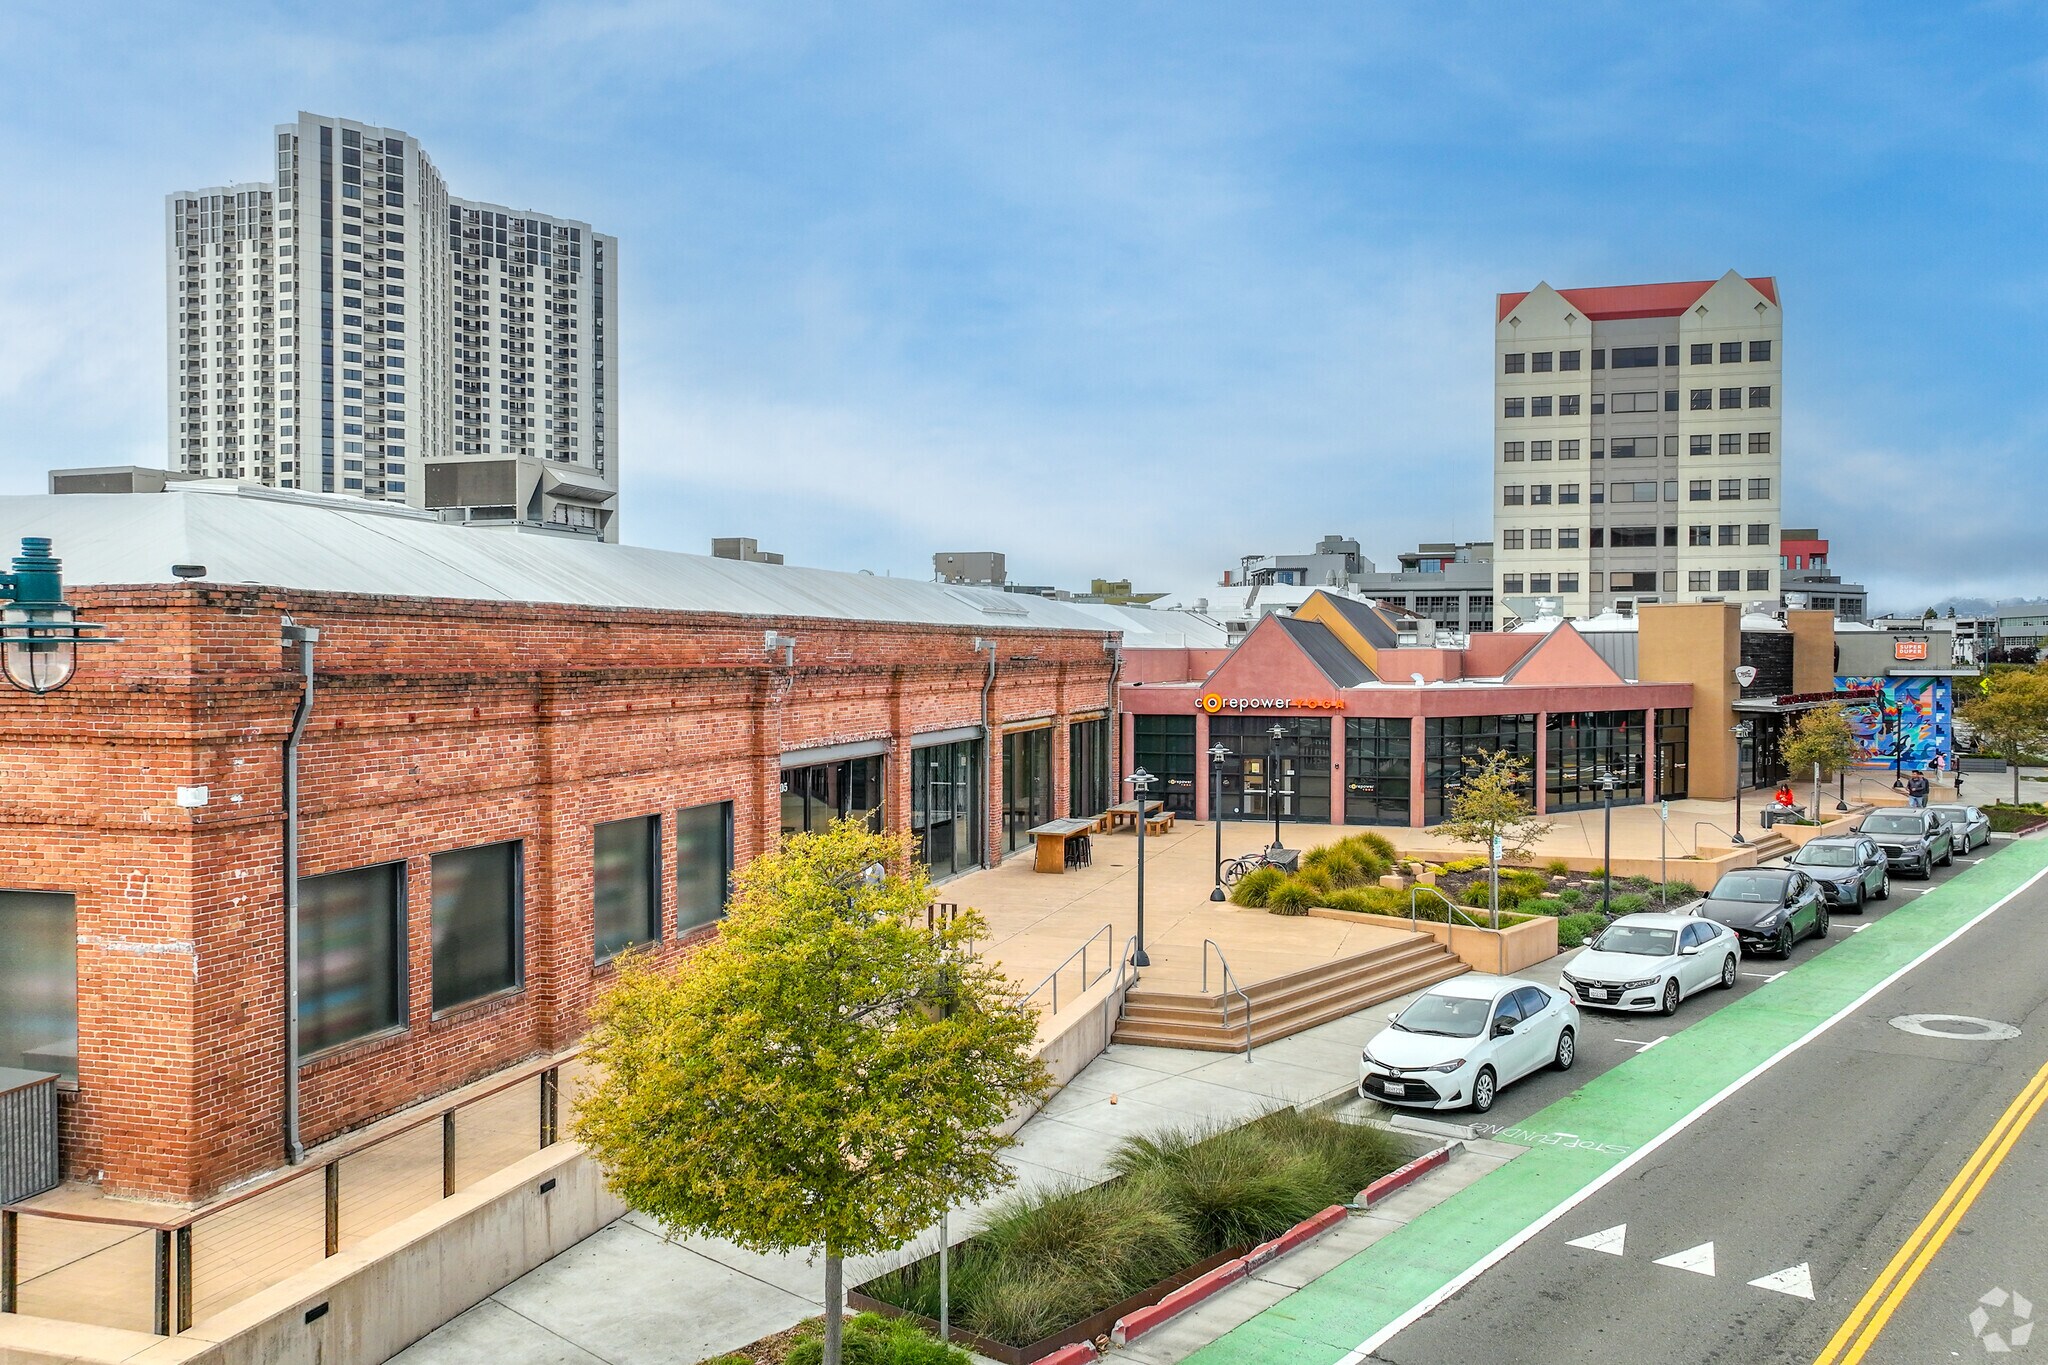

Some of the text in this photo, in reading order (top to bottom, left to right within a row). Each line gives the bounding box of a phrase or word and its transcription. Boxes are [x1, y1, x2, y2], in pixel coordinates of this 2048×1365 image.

[1194, 694, 1345, 712] corepower YOGA
[1468, 1122, 1631, 1154] STOP FUNDING
